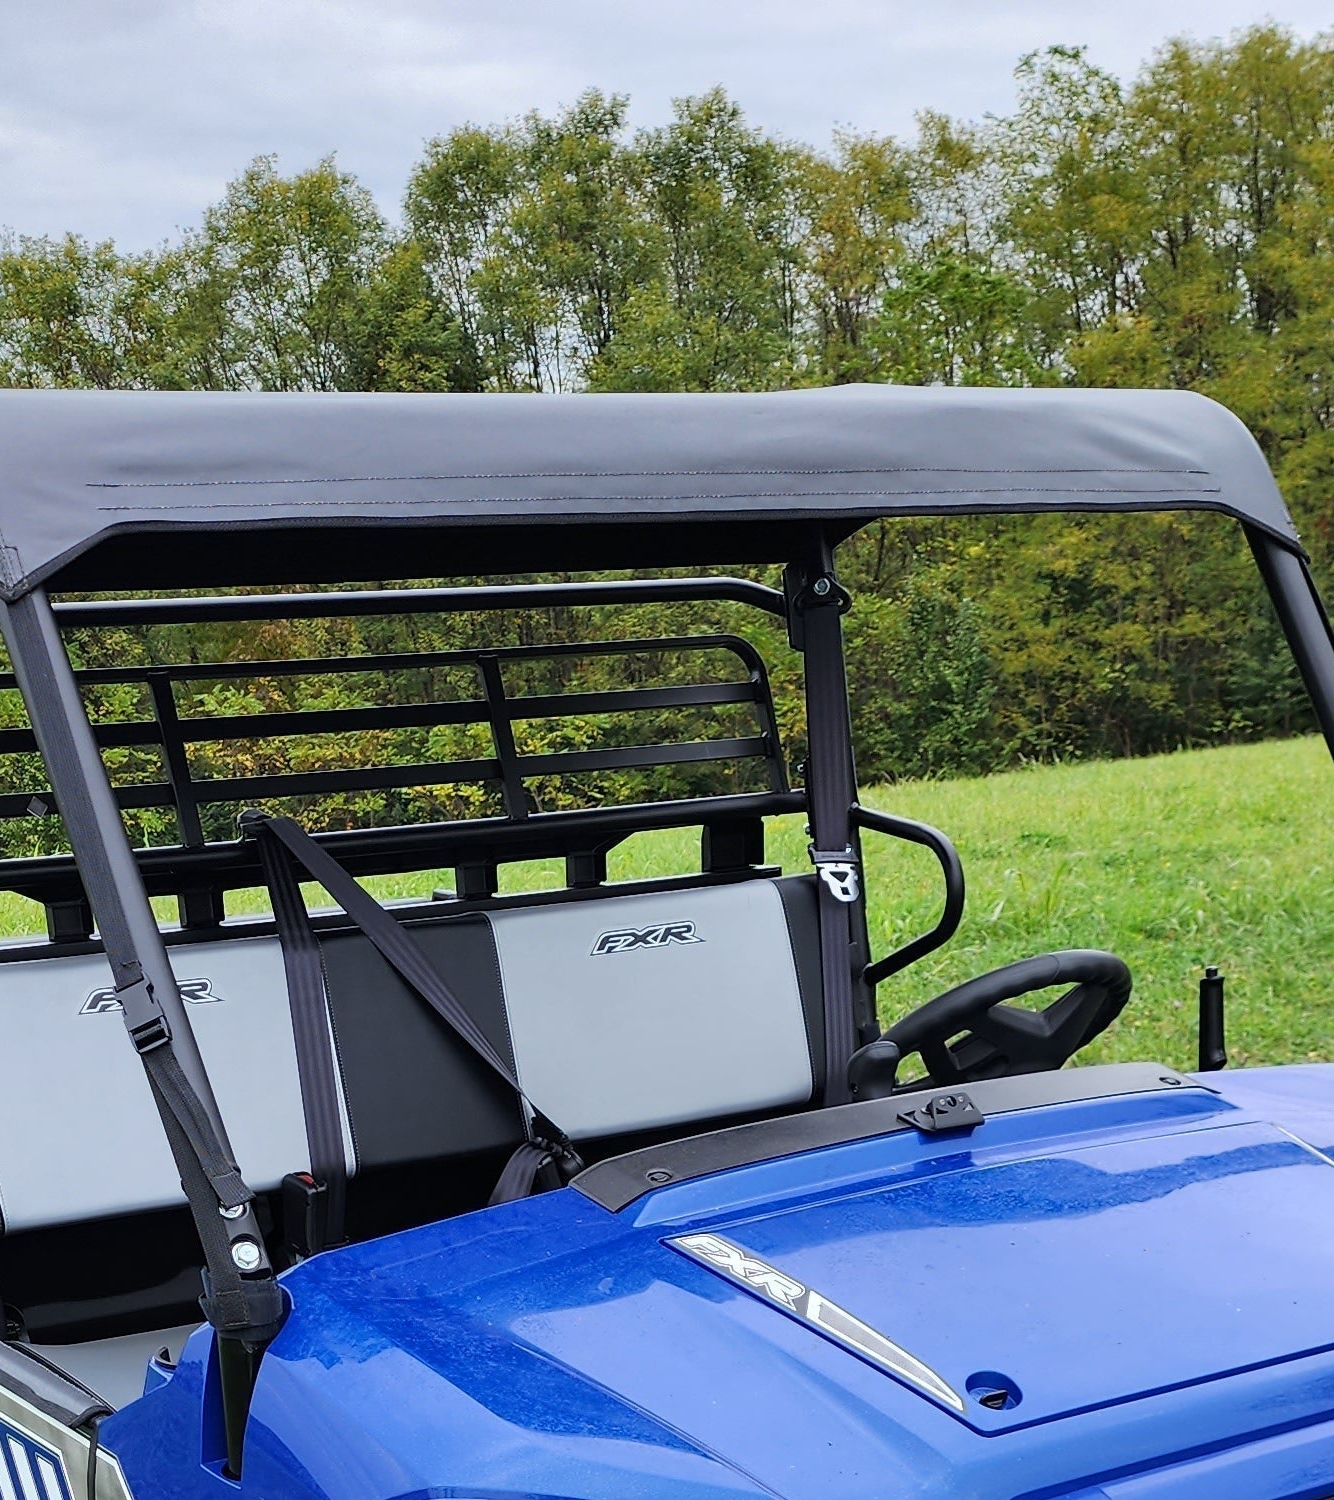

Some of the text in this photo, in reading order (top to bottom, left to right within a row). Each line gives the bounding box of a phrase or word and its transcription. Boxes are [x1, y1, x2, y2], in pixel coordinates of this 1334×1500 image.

[590, 920, 706, 956] FXR
[78, 977, 226, 1015] FR
[675, 1233, 806, 1311] FXR
